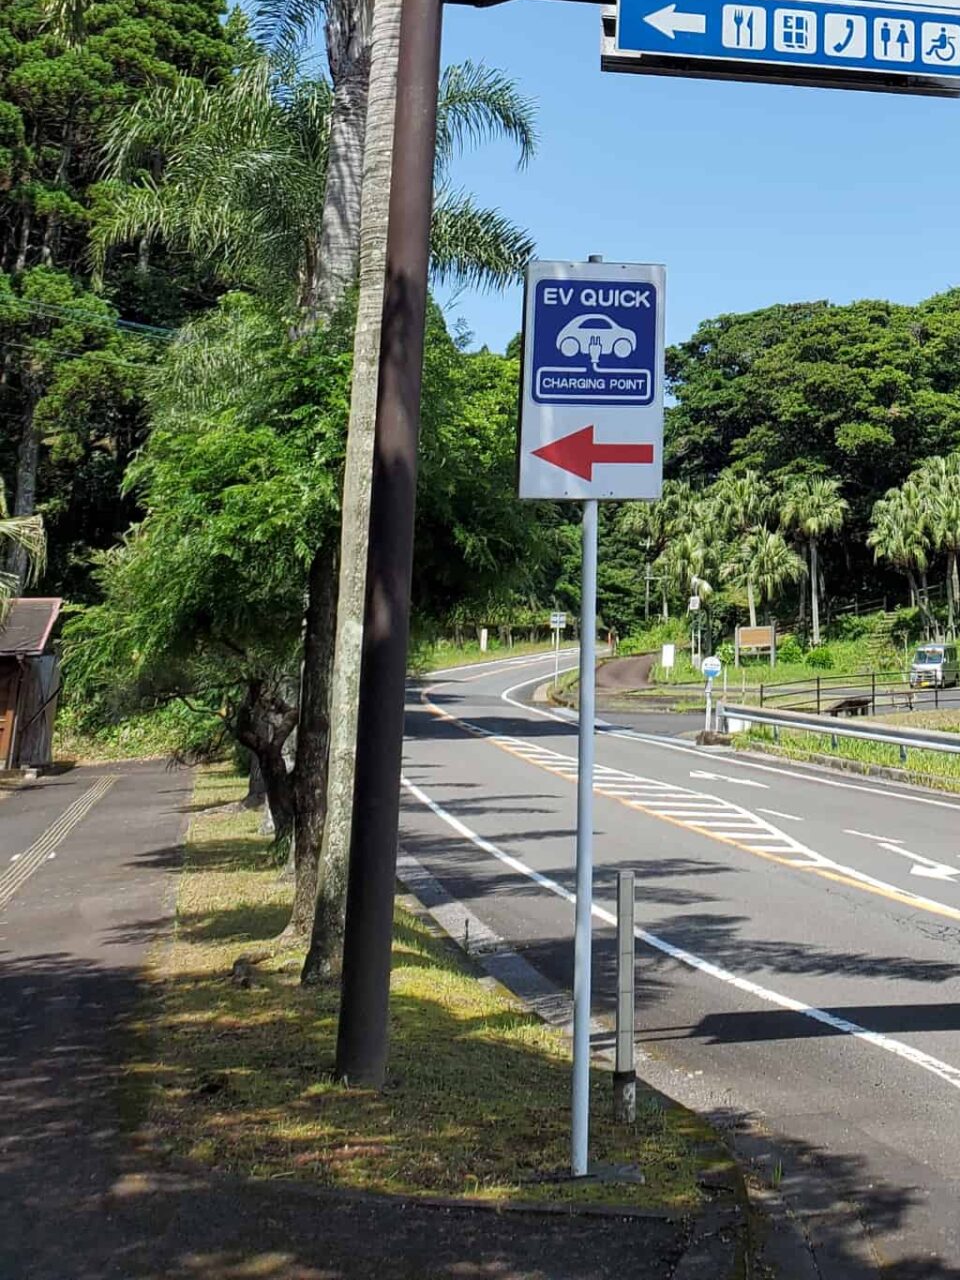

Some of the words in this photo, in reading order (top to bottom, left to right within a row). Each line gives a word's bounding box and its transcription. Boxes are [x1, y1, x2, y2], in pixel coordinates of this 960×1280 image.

[543, 287, 573, 306] EV
[580, 288, 651, 308] QUICK
[542, 377, 606, 390] CHARGING
[609, 378, 646, 391] POINT
